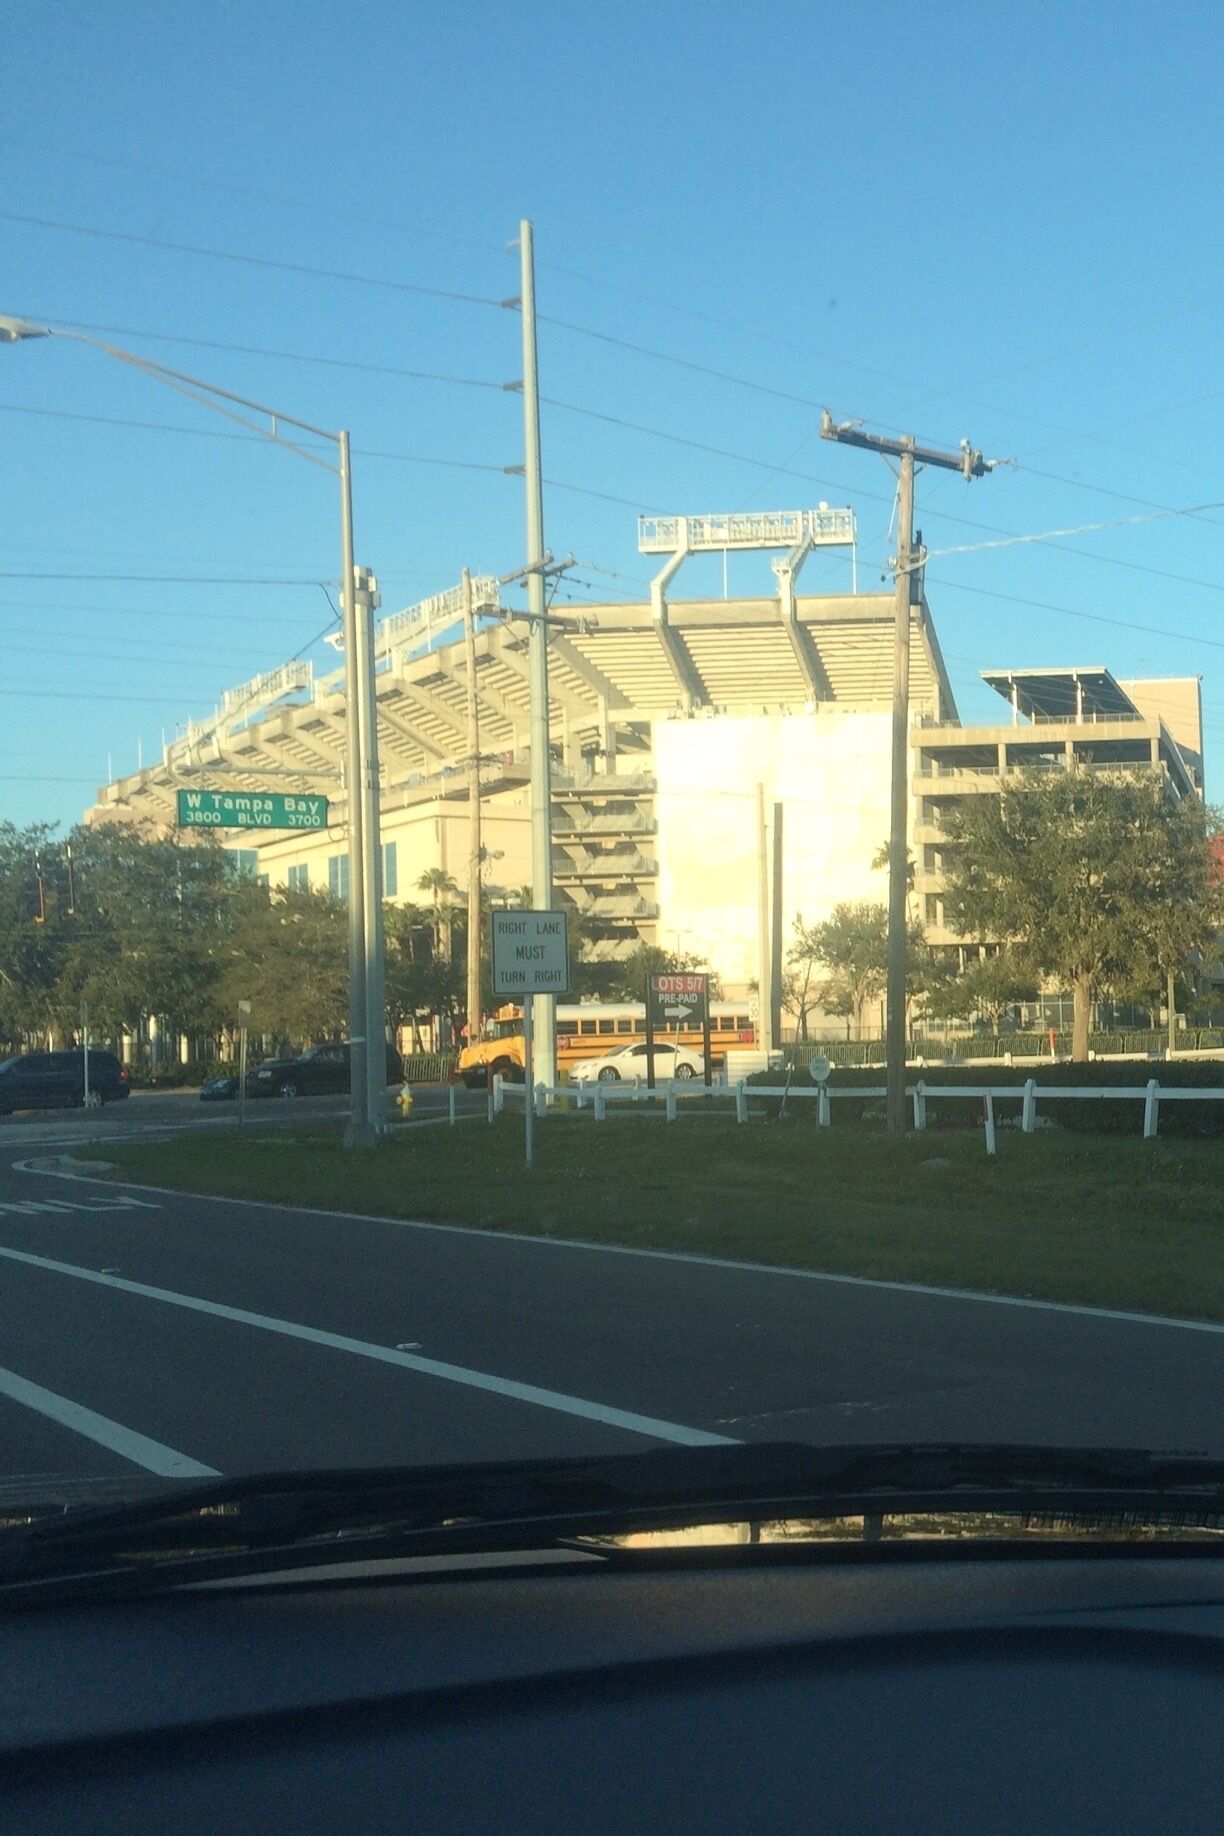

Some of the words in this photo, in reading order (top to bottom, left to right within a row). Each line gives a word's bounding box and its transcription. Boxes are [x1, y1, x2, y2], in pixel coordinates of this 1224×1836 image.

[186, 794, 201, 809] W
[212, 795, 273, 812] Tampa
[284, 798, 319, 814] Bay
[186, 811, 221, 823] 3800
[238, 813, 272, 825] BLVD
[288, 814, 321, 826] 3700
[498, 922, 527, 934] RIGHT
[536, 922, 561, 934] LANE
[515, 945, 546, 960] MUST
[500, 970, 526, 983] TURN
[534, 970, 561, 983] RIGHT
[651, 976, 684, 991] LOTS
[687, 976, 704, 991] 5/7
[658, 993, 698, 1004] PRE-PAID
